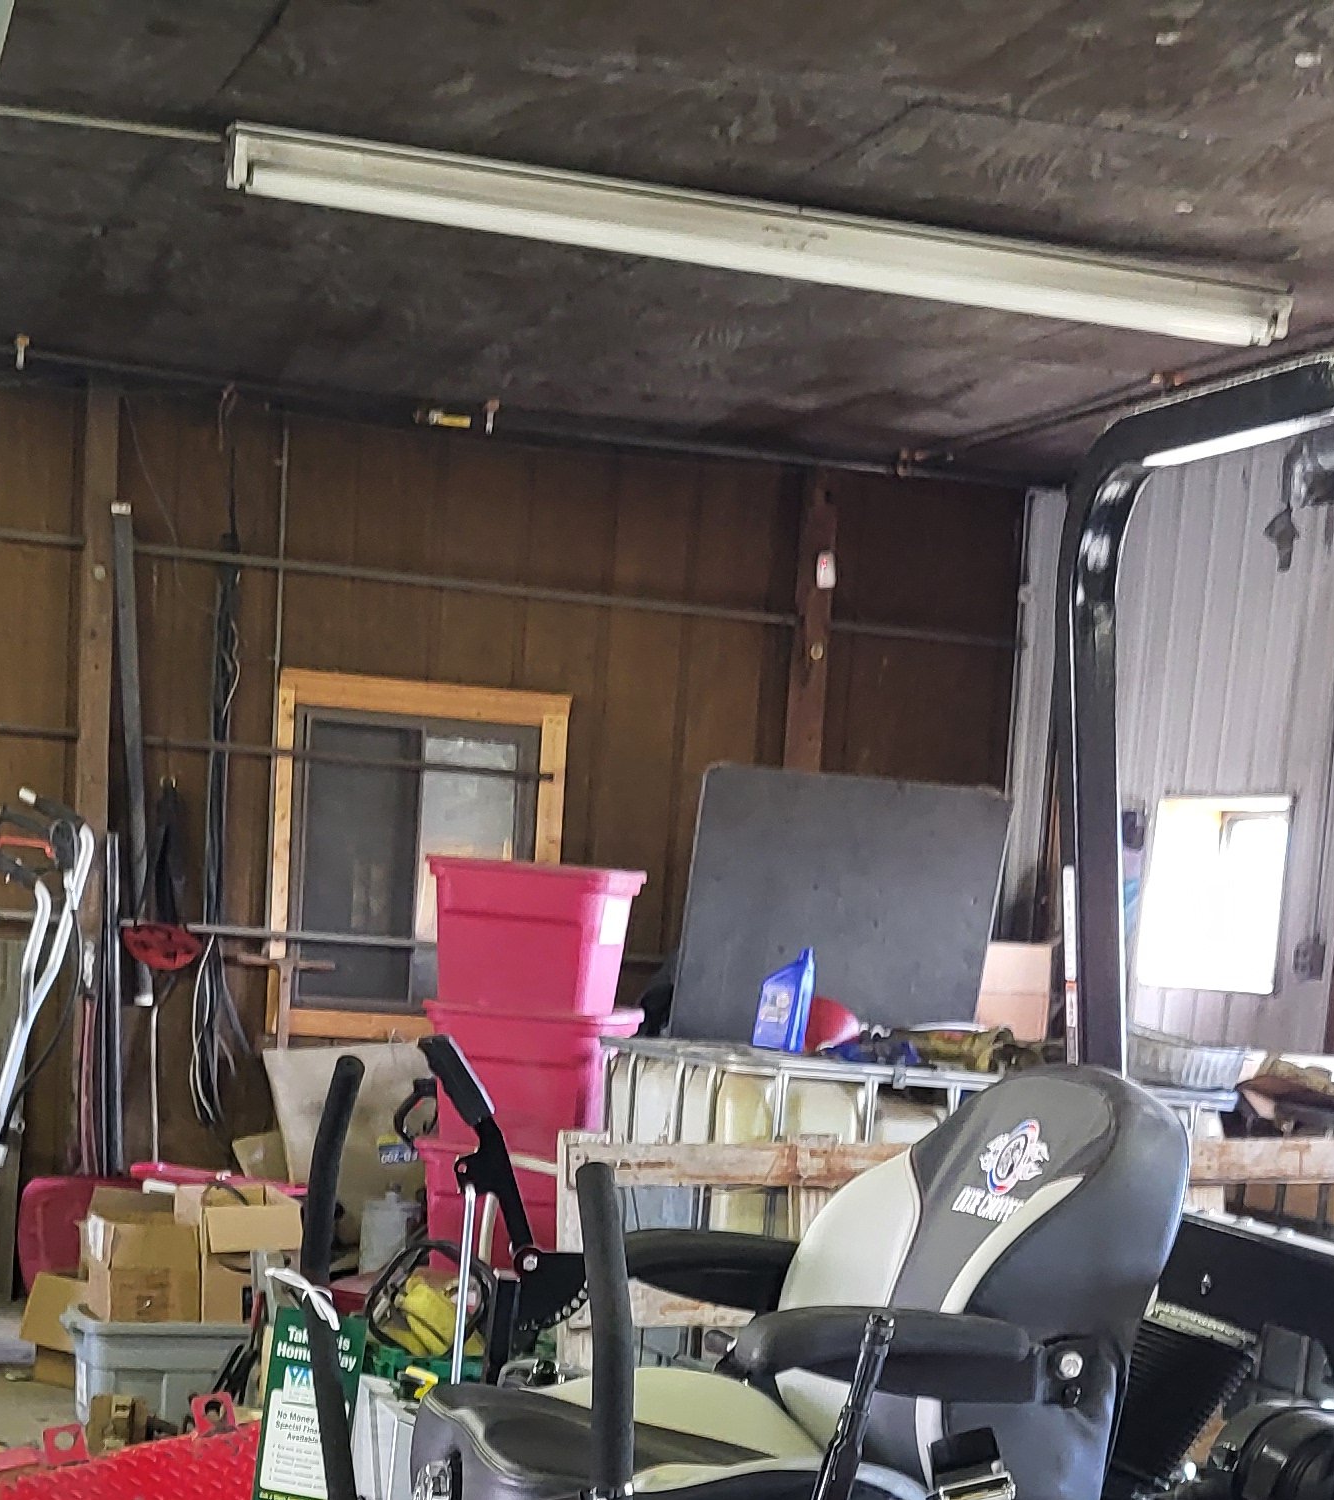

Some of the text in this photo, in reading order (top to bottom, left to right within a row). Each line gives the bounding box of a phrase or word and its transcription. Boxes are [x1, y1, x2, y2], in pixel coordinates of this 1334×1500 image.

[287, 1325, 309, 1345] Tak
[275, 1420, 302, 1432] Special
[277, 1410, 315, 1426] No Money
